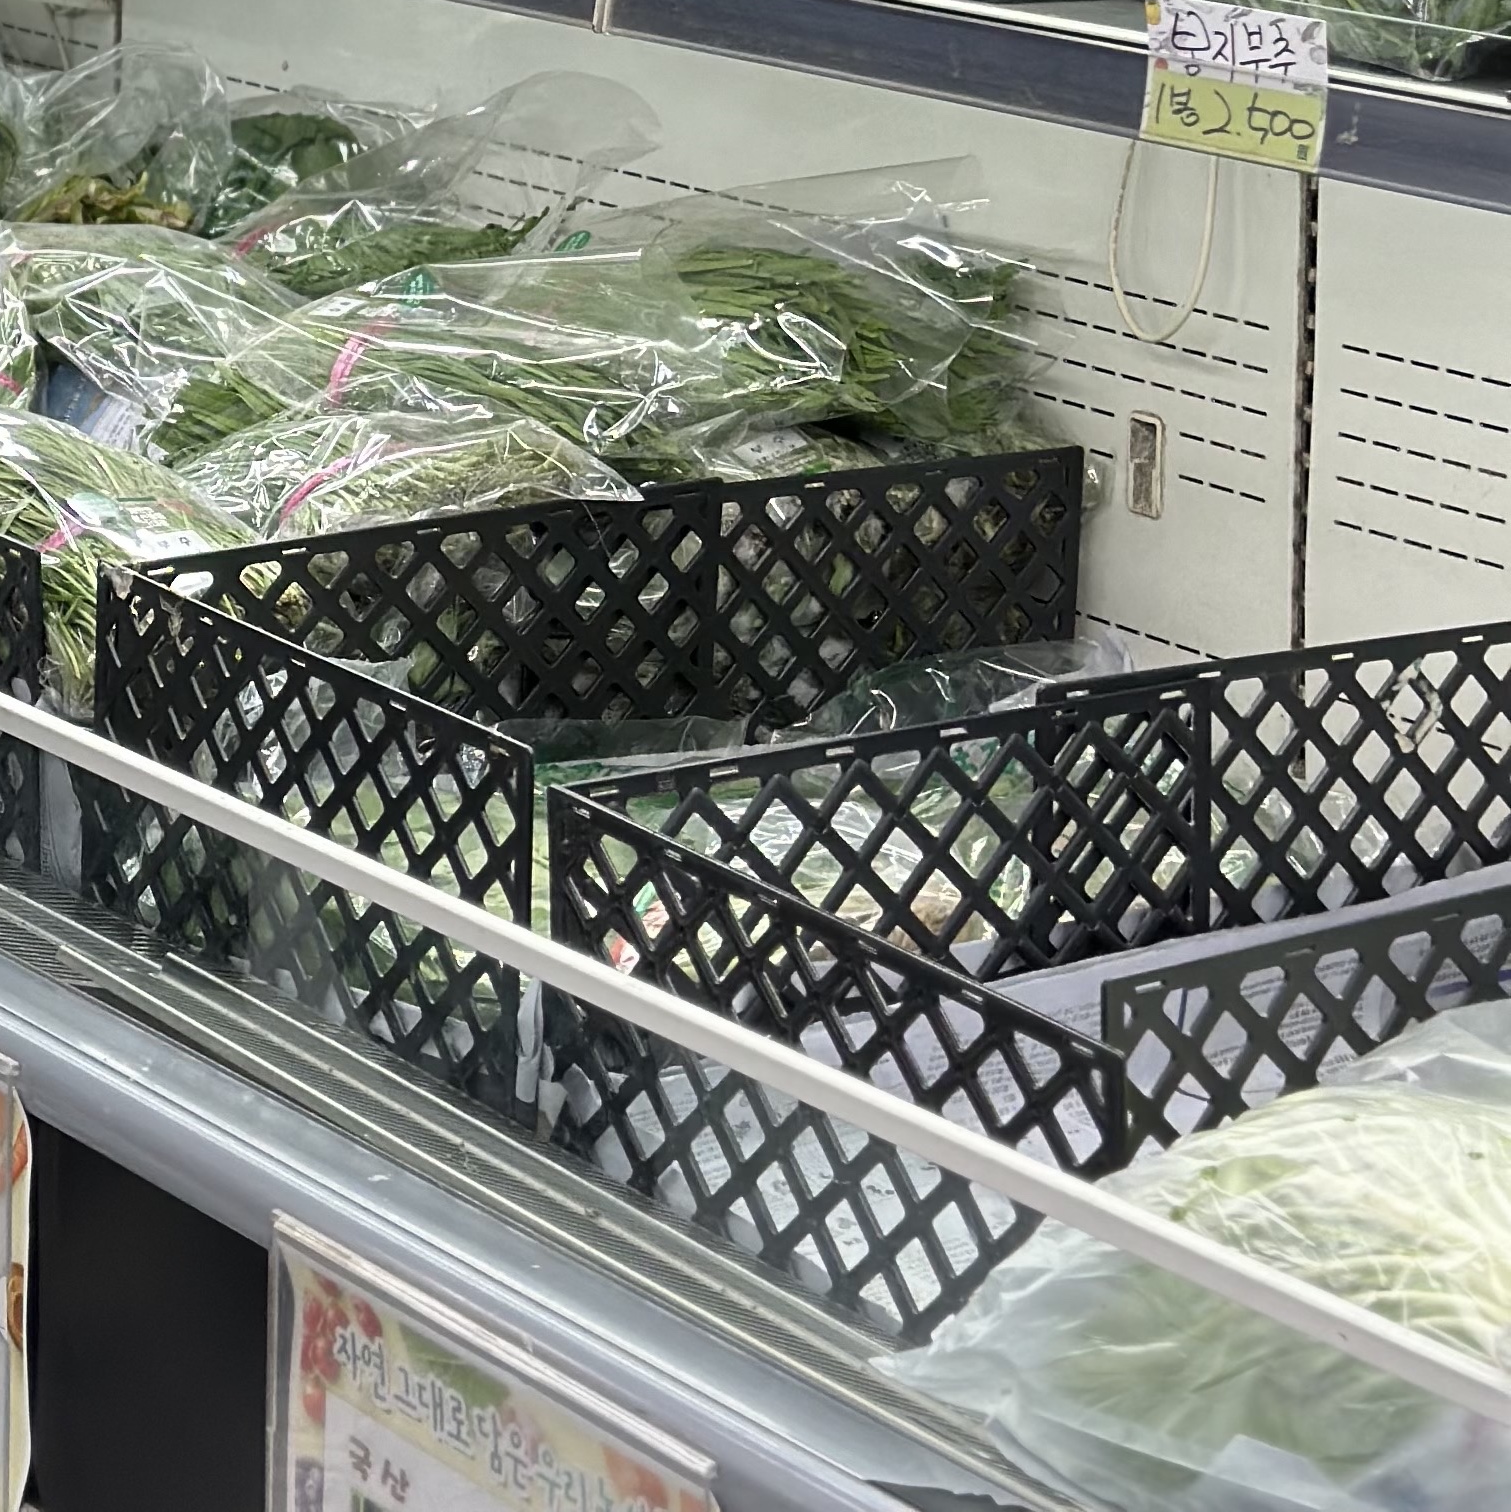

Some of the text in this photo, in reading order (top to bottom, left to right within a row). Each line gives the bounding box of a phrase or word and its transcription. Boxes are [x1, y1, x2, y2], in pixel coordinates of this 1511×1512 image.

[1170, 10, 1297, 84] 봉지부추
[335, 1328, 387, 1402] 자연
[391, 1364, 473, 1450] 그대로
[474, 1408, 534, 1491] 담은
[347, 1435, 409, 1503] 국산
